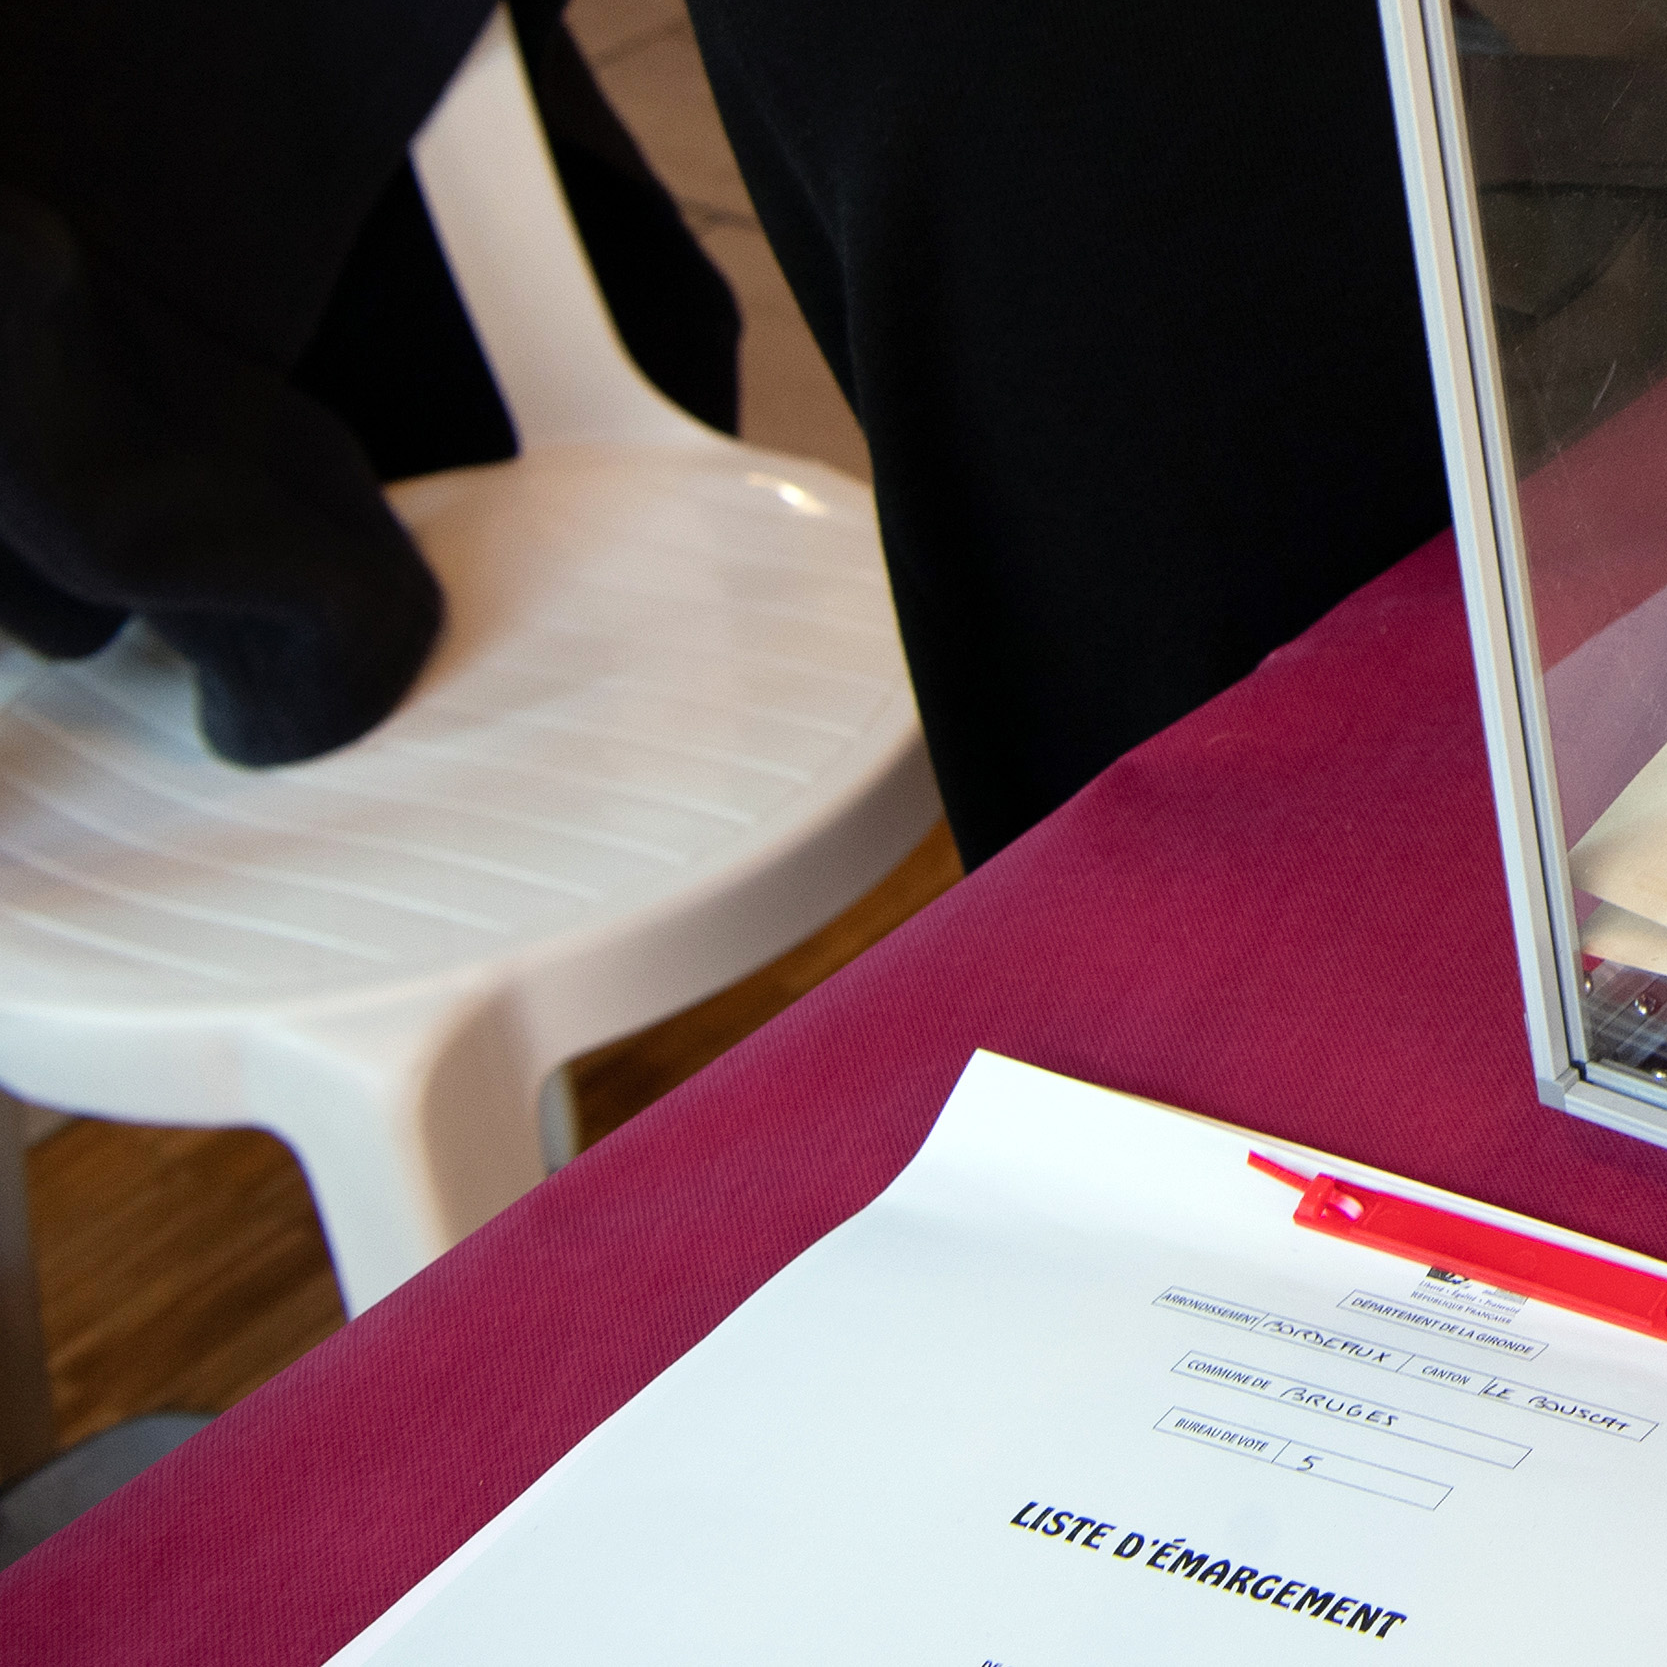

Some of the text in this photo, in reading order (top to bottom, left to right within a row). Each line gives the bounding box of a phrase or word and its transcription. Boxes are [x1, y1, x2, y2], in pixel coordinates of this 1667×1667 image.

[1161, 1292, 1259, 1326] ARRONDISSEMENT
[1351, 1297, 1535, 1355] DÉPARTEMENT DE LA GIRONDE
[1262, 1319, 1391, 1363] BORDEAUX
[1187, 1359, 1272, 1390] COMMUNE DE
[1421, 1365, 1471, 1385] CANTON
[1279, 1387, 1399, 1427] BRUGES
[1482, 1383, 1631, 1432] LE BOUSCAT
[1174, 1417, 1270, 1453] BUREAU DE VOTE
[1296, 1455, 1324, 1472] 5
[1009, 1500, 1408, 1640] LISTE D'ÉMARGEMENT
